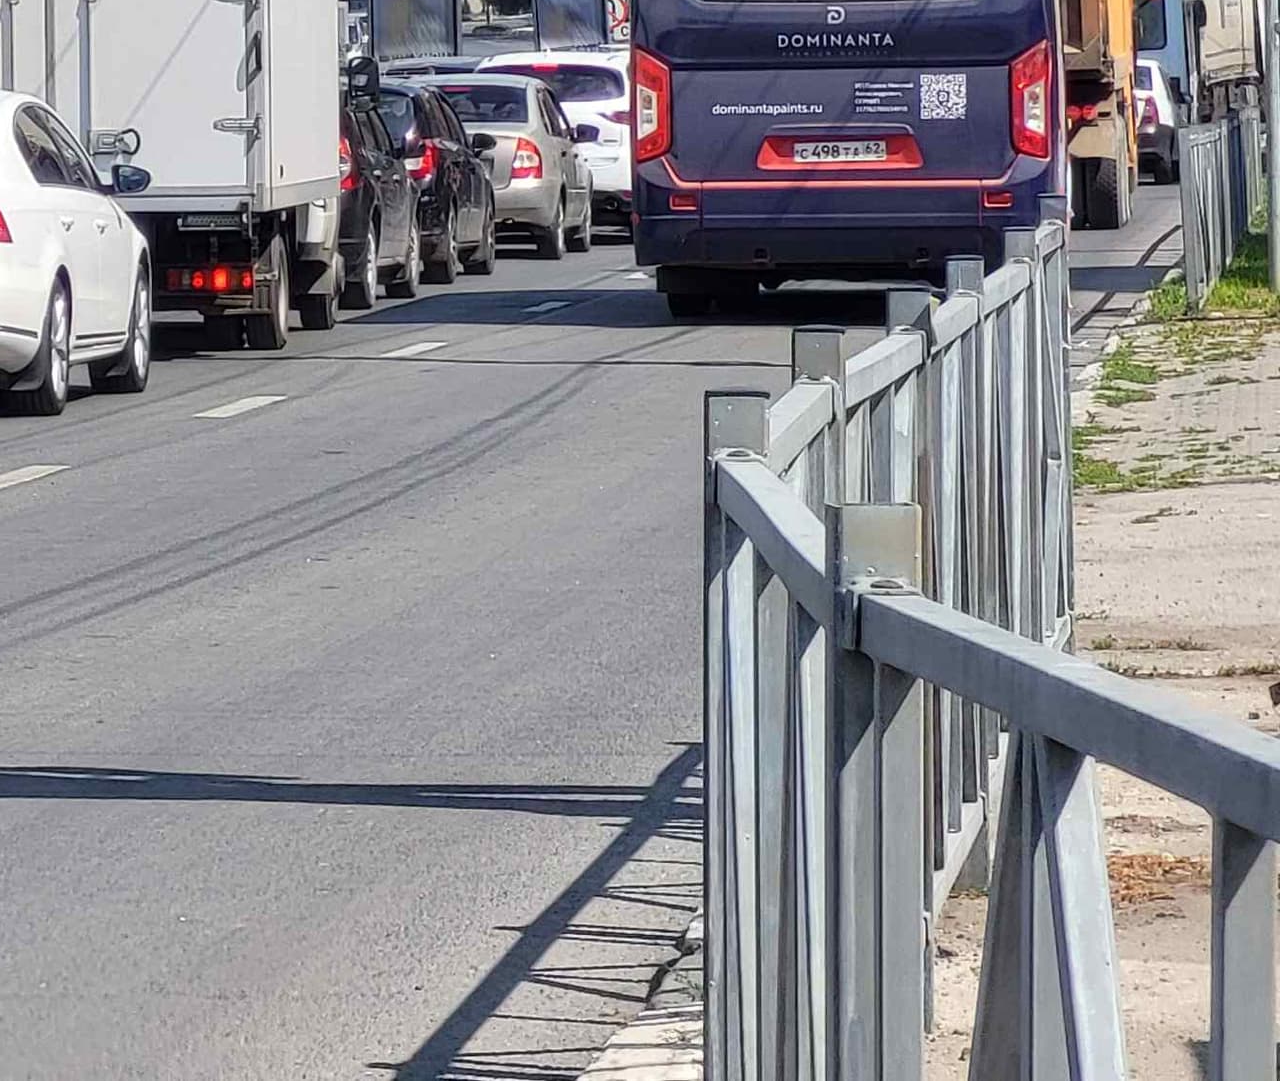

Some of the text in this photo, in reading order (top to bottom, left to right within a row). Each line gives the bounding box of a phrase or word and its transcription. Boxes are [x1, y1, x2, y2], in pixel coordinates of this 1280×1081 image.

[777, 33, 895, 48] DOMINANTA
[712, 103, 823, 116] dominantapaints.ru
[864, 142, 881, 155] 62
